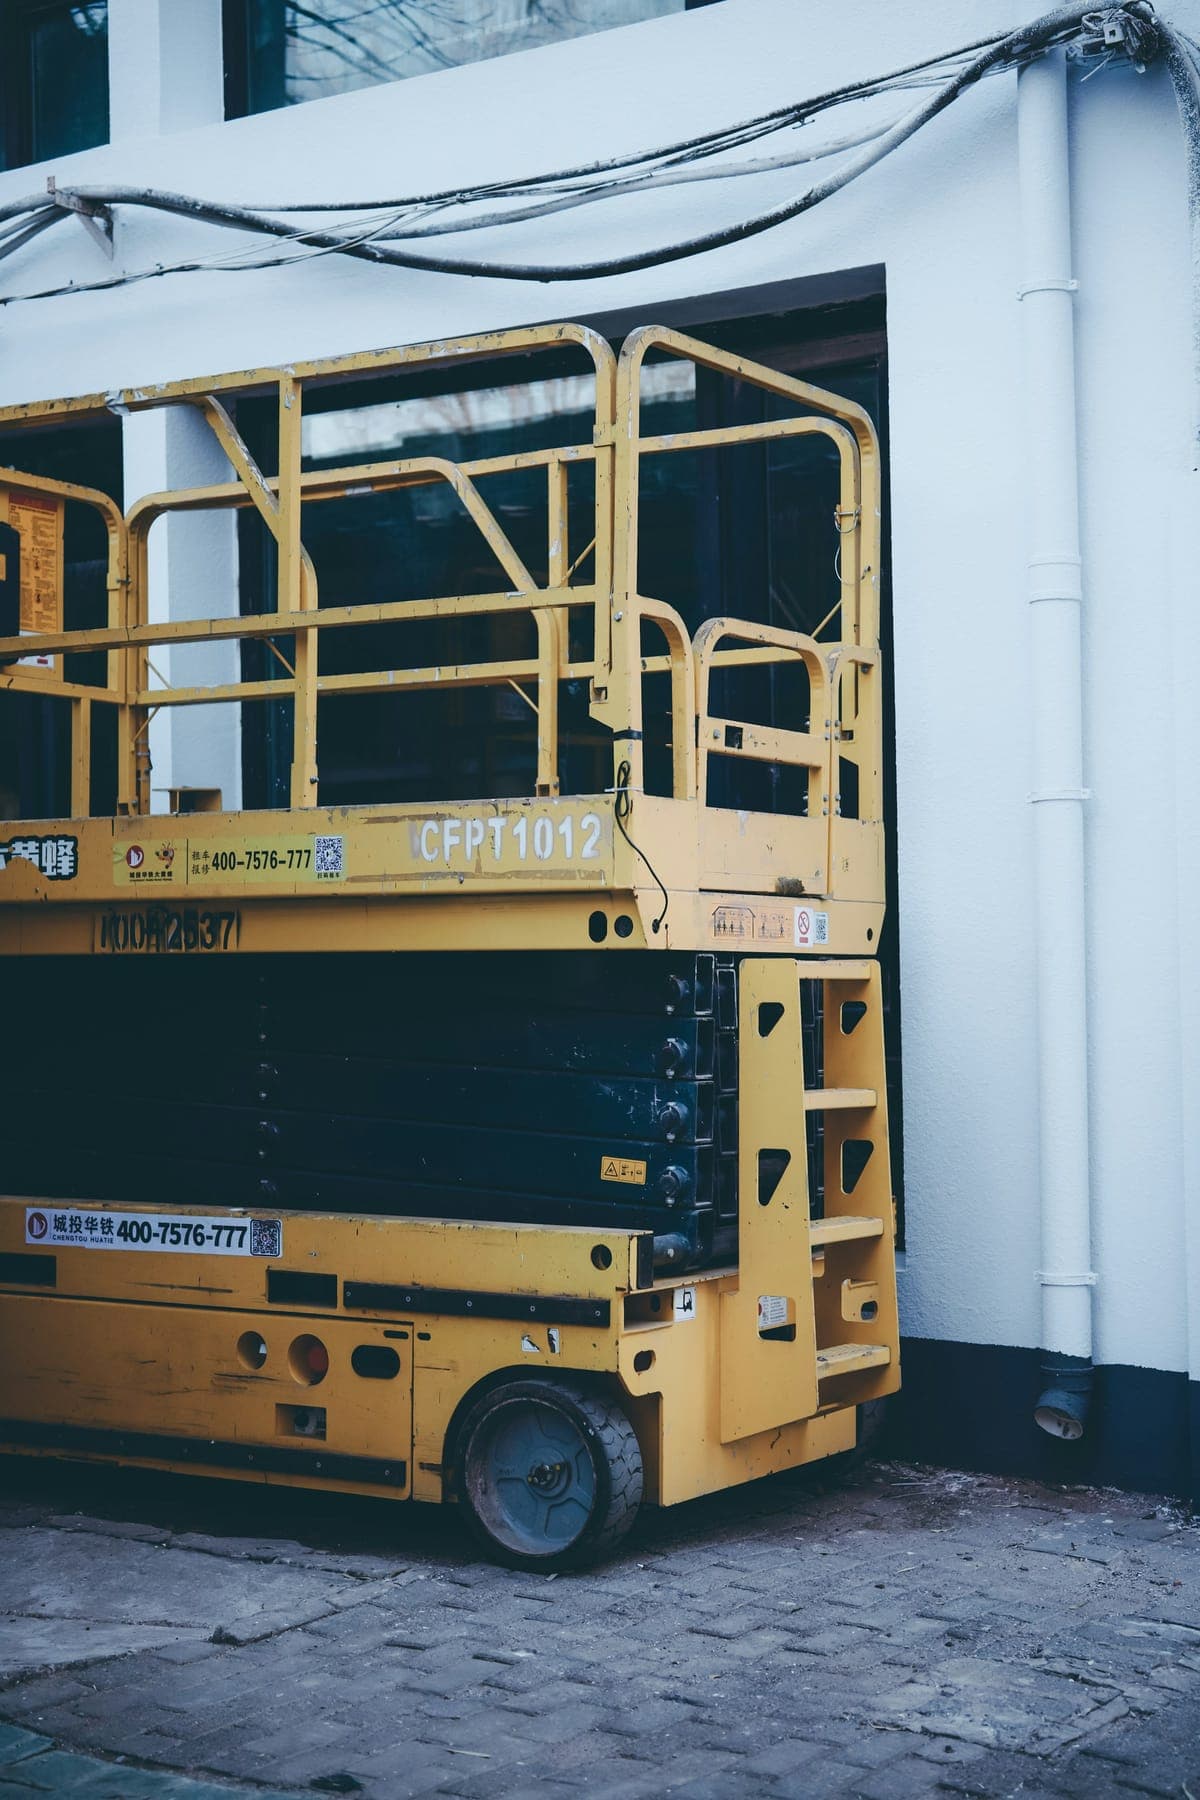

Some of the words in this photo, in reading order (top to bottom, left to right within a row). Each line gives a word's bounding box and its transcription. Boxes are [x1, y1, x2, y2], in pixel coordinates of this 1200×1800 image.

[212, 849, 311, 871] 400-7576-777
[53, 1214, 114, 1236] 城投华铁
[117, 1220, 248, 1248] 400-7576-777
[52, 1233, 88, 1243] CHENGTOU
[90, 1236, 114, 1244] HUATIE
